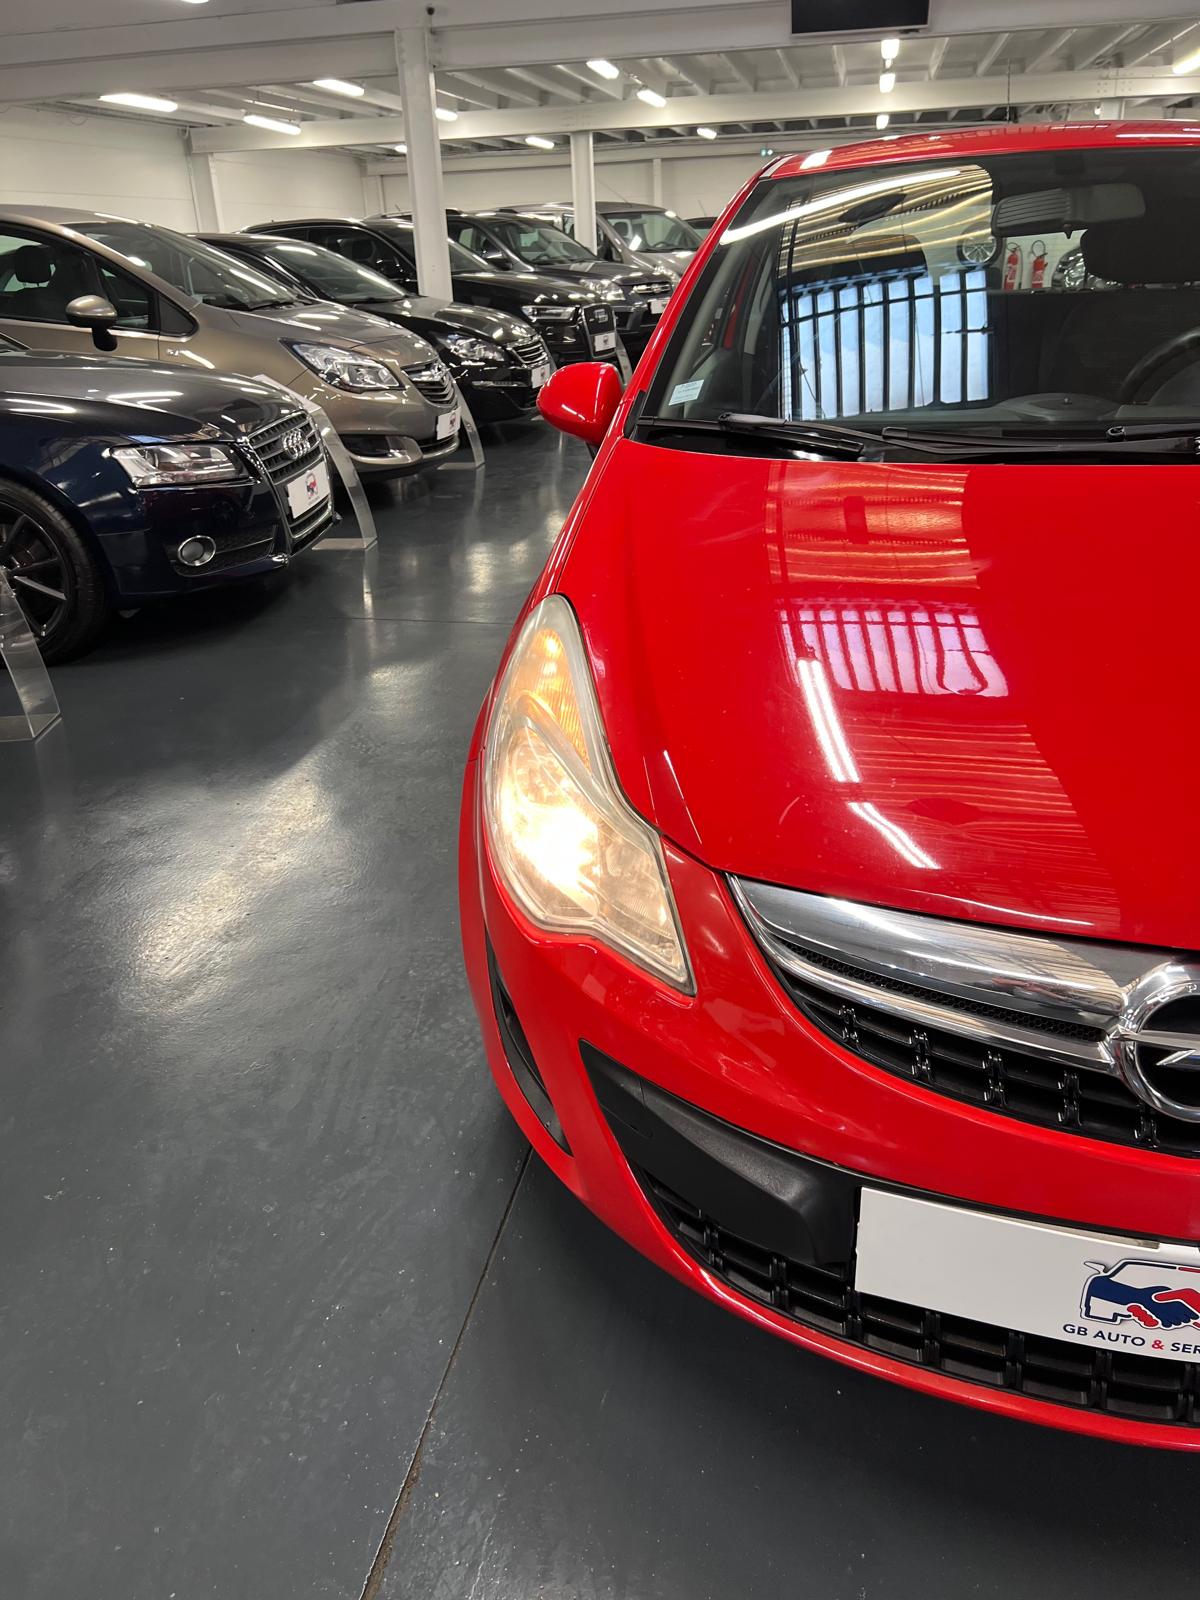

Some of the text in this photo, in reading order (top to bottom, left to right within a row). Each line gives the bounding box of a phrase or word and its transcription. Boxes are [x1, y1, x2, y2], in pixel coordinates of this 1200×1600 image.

[1063, 1324, 1088, 1336] GB
[1093, 1330, 1145, 1346] AUTO
[1152, 1340, 1165, 1350] &
